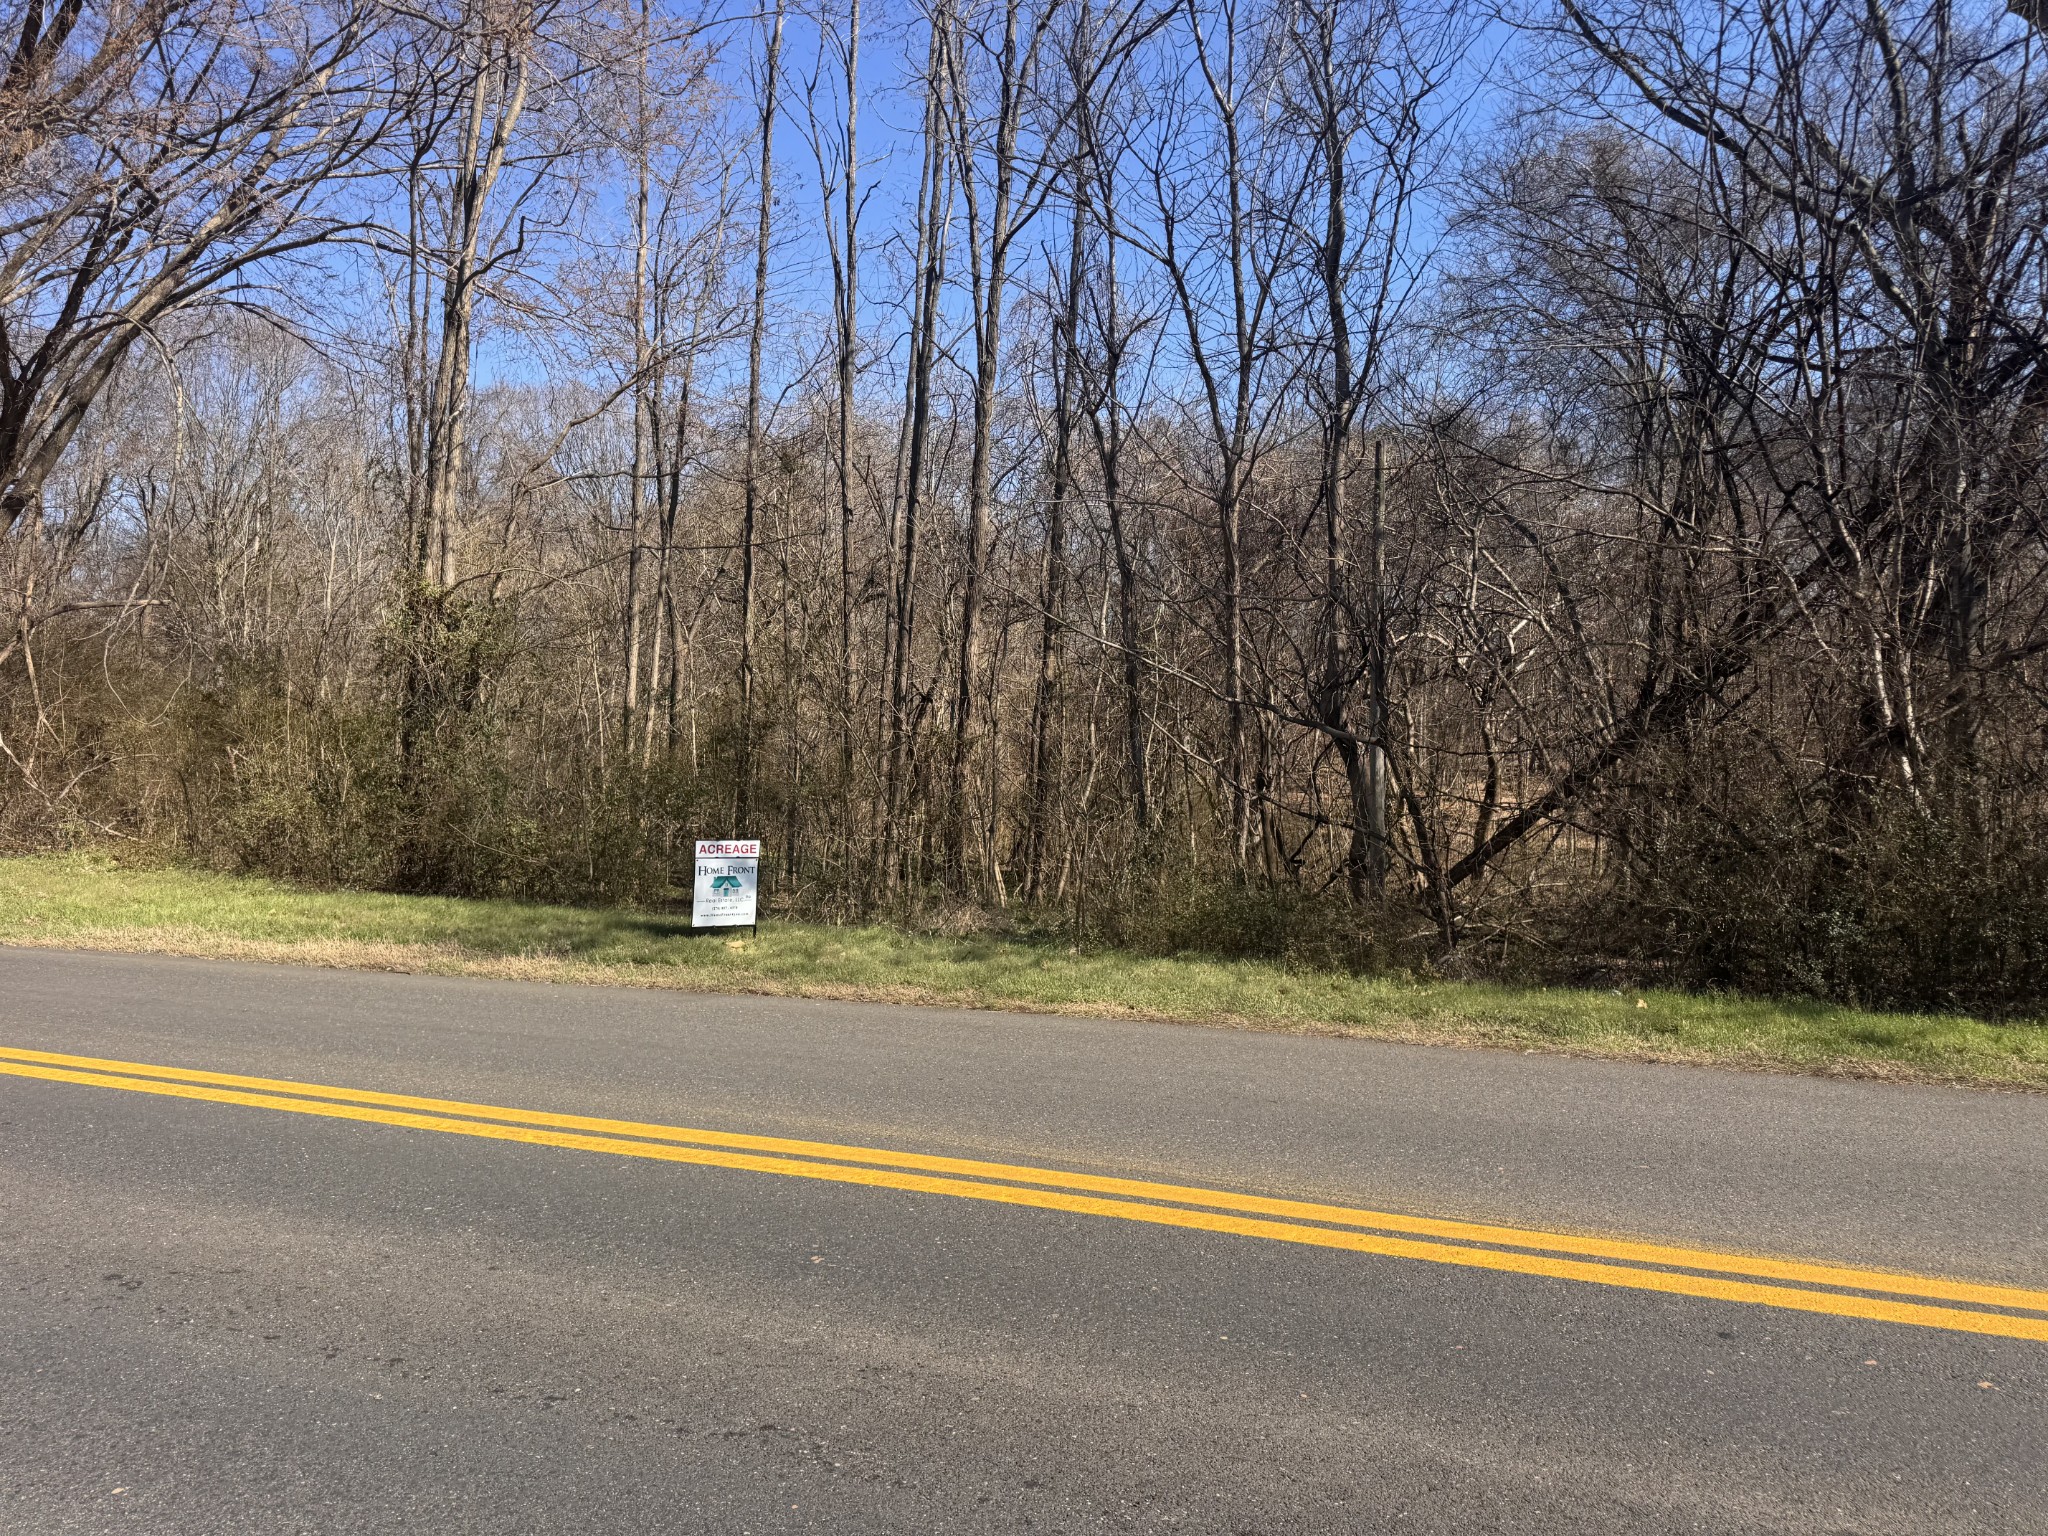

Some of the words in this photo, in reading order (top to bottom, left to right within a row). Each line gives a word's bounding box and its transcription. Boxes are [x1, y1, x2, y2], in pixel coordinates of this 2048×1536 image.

[699, 844, 757, 854] ACREAGE
[698, 865, 724, 876] HOME
[727, 865, 756, 875] FRONT
